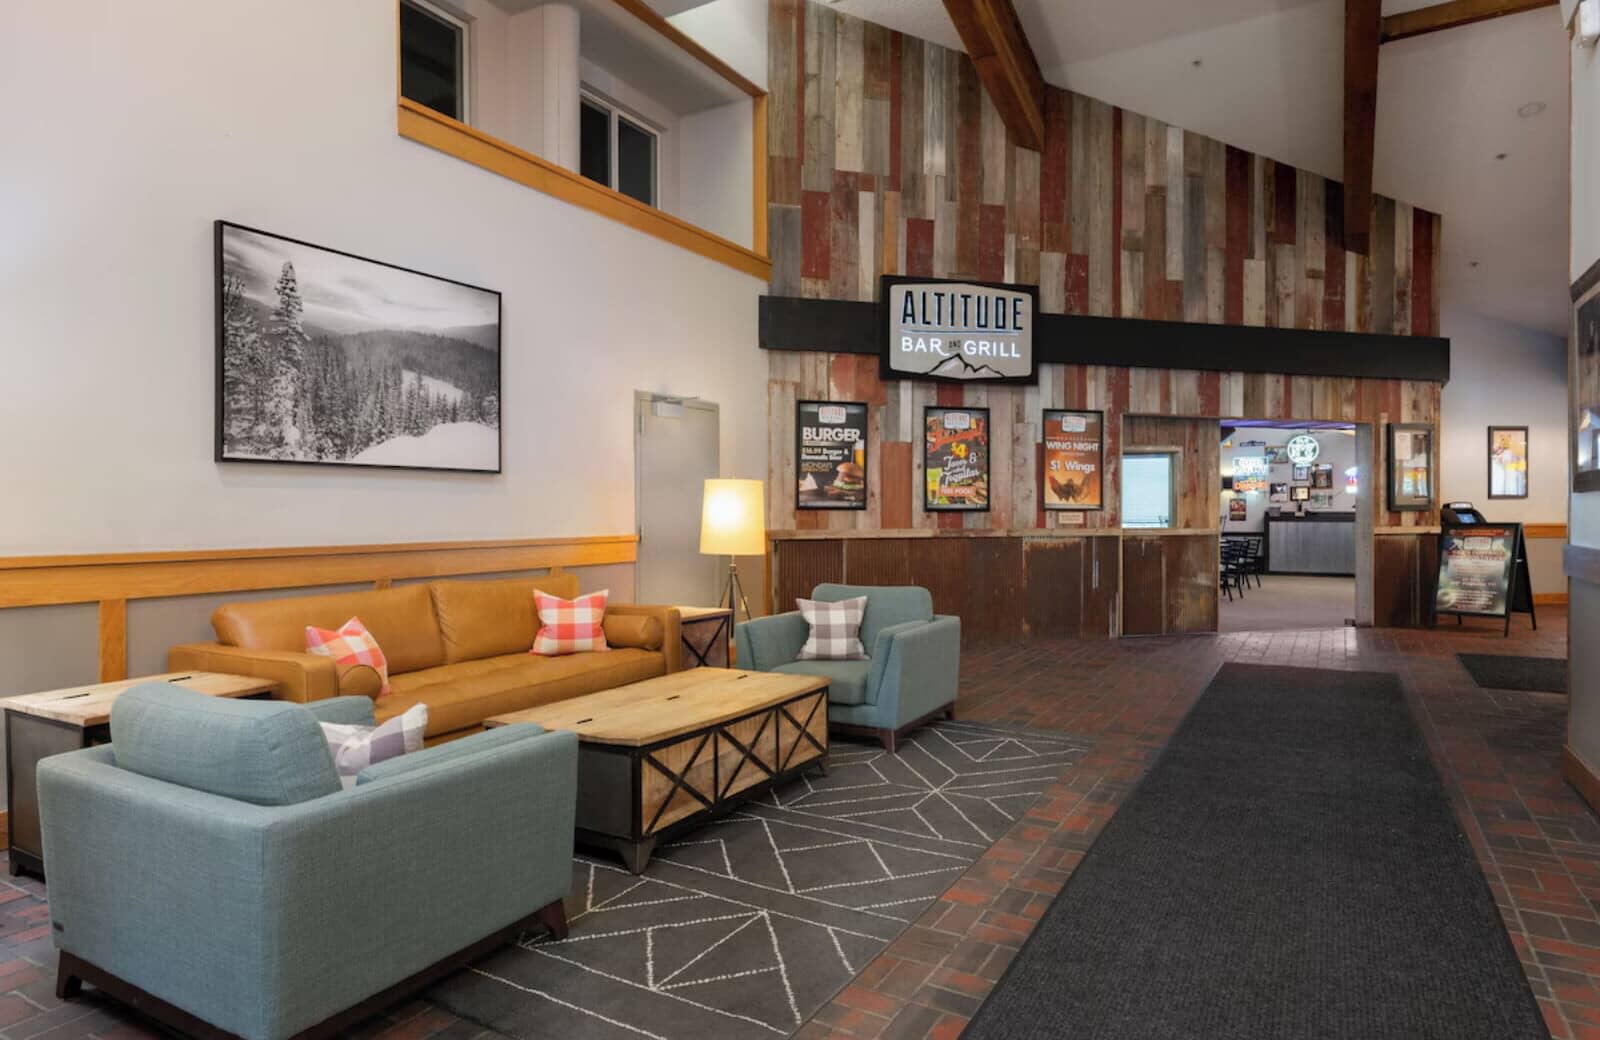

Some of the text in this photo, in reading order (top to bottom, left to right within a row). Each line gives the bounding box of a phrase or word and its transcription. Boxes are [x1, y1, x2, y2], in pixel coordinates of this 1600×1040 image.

[901, 290, 1023, 331] ALTITUDE
[901, 336, 950, 356] BAR
[963, 340, 1021, 358] GRILL
[802, 427, 861, 442] BURGER
[951, 442, 967, 458] $4
[1046, 441, 1099, 452] WING NIGHT
[1050, 460, 1095, 474] $1 Wings
